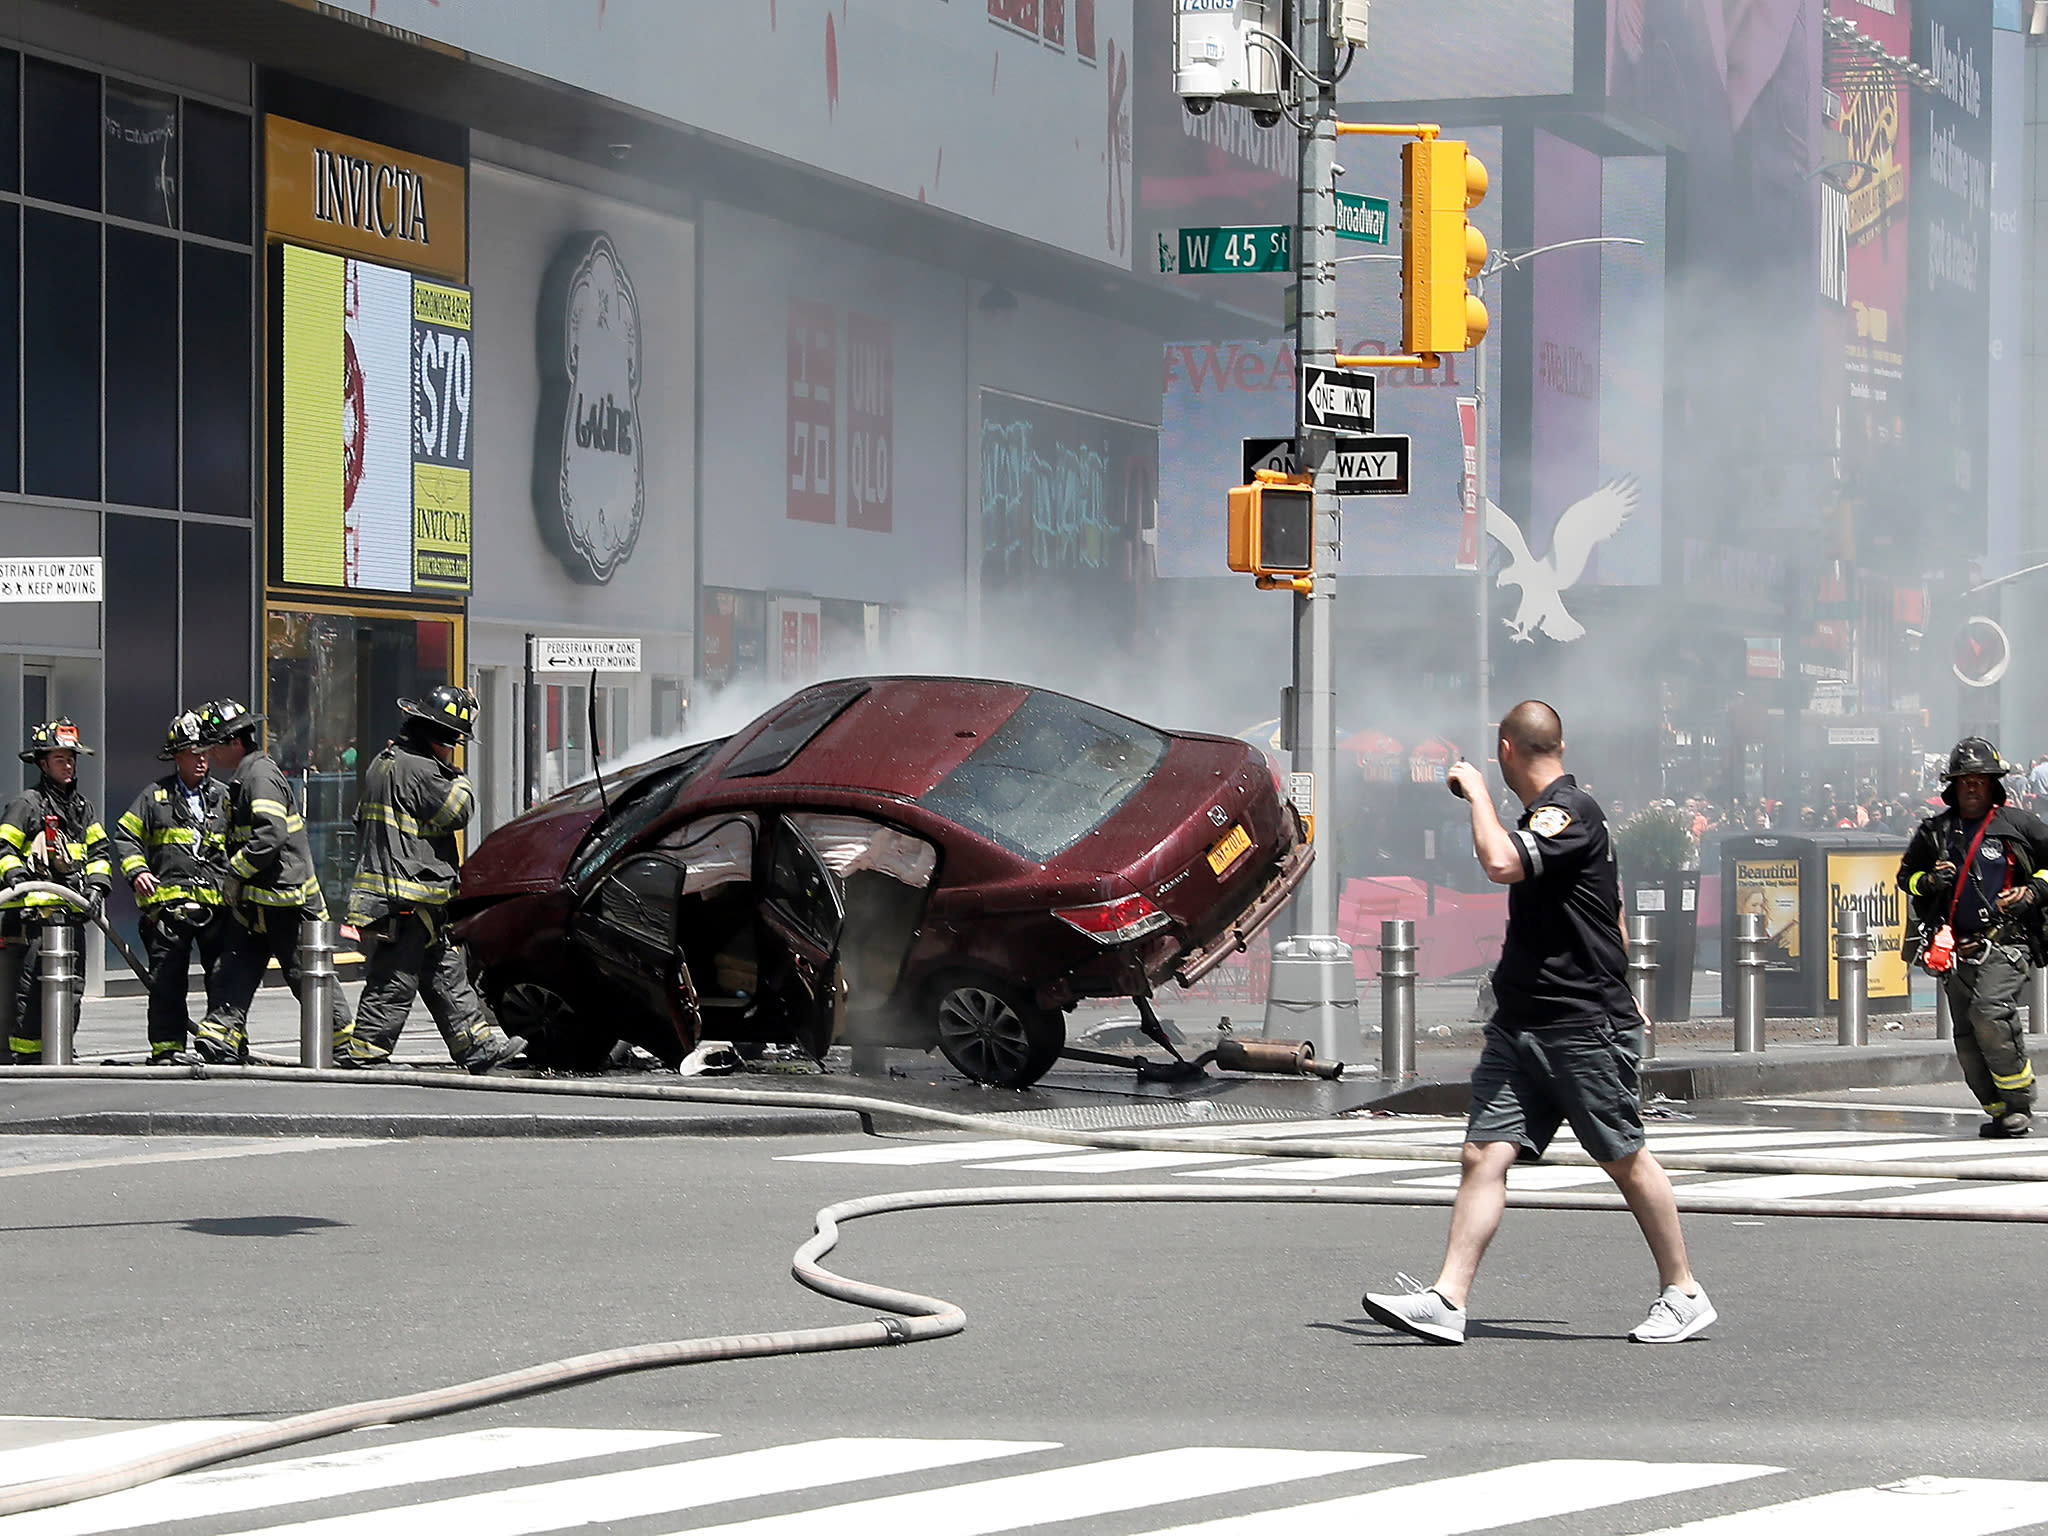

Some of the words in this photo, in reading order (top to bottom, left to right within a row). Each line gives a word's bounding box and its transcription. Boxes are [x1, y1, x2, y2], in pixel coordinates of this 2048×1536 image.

[1966, 47, 1981, 119] the
[312, 147, 429, 245] INVICTA
[1336, 199, 1385, 245] Broadway
[1186, 234, 1210, 268] W
[1224, 233, 1257, 267] 45
[1270, 232, 1288, 254] St
[414, 327, 421, 353] AT
[421, 330, 471, 461] $79
[1314, 386, 1336, 411] ONE
[1344, 388, 1367, 417] WAY
[1268, 456, 1296, 475] ON
[1337, 455, 1387, 478] WAY
[417, 507, 468, 543] INVICTA
[38, 563, 66, 577] FLOW
[69, 563, 95, 577] ZONE
[28, 582, 53, 595] KEEP
[56, 581, 96, 595] MOVING
[546, 643, 593, 654] PEDESTRIAN
[594, 643, 614, 654] FLOW
[616, 643, 636, 654] ZONE
[586, 656, 604, 667] KEEP
[607, 656, 636, 667] MOVING
[1738, 864, 1798, 879] Beautiful
[1831, 881, 1900, 928] Beautiful
[1878, 934, 1901, 951] Musical
